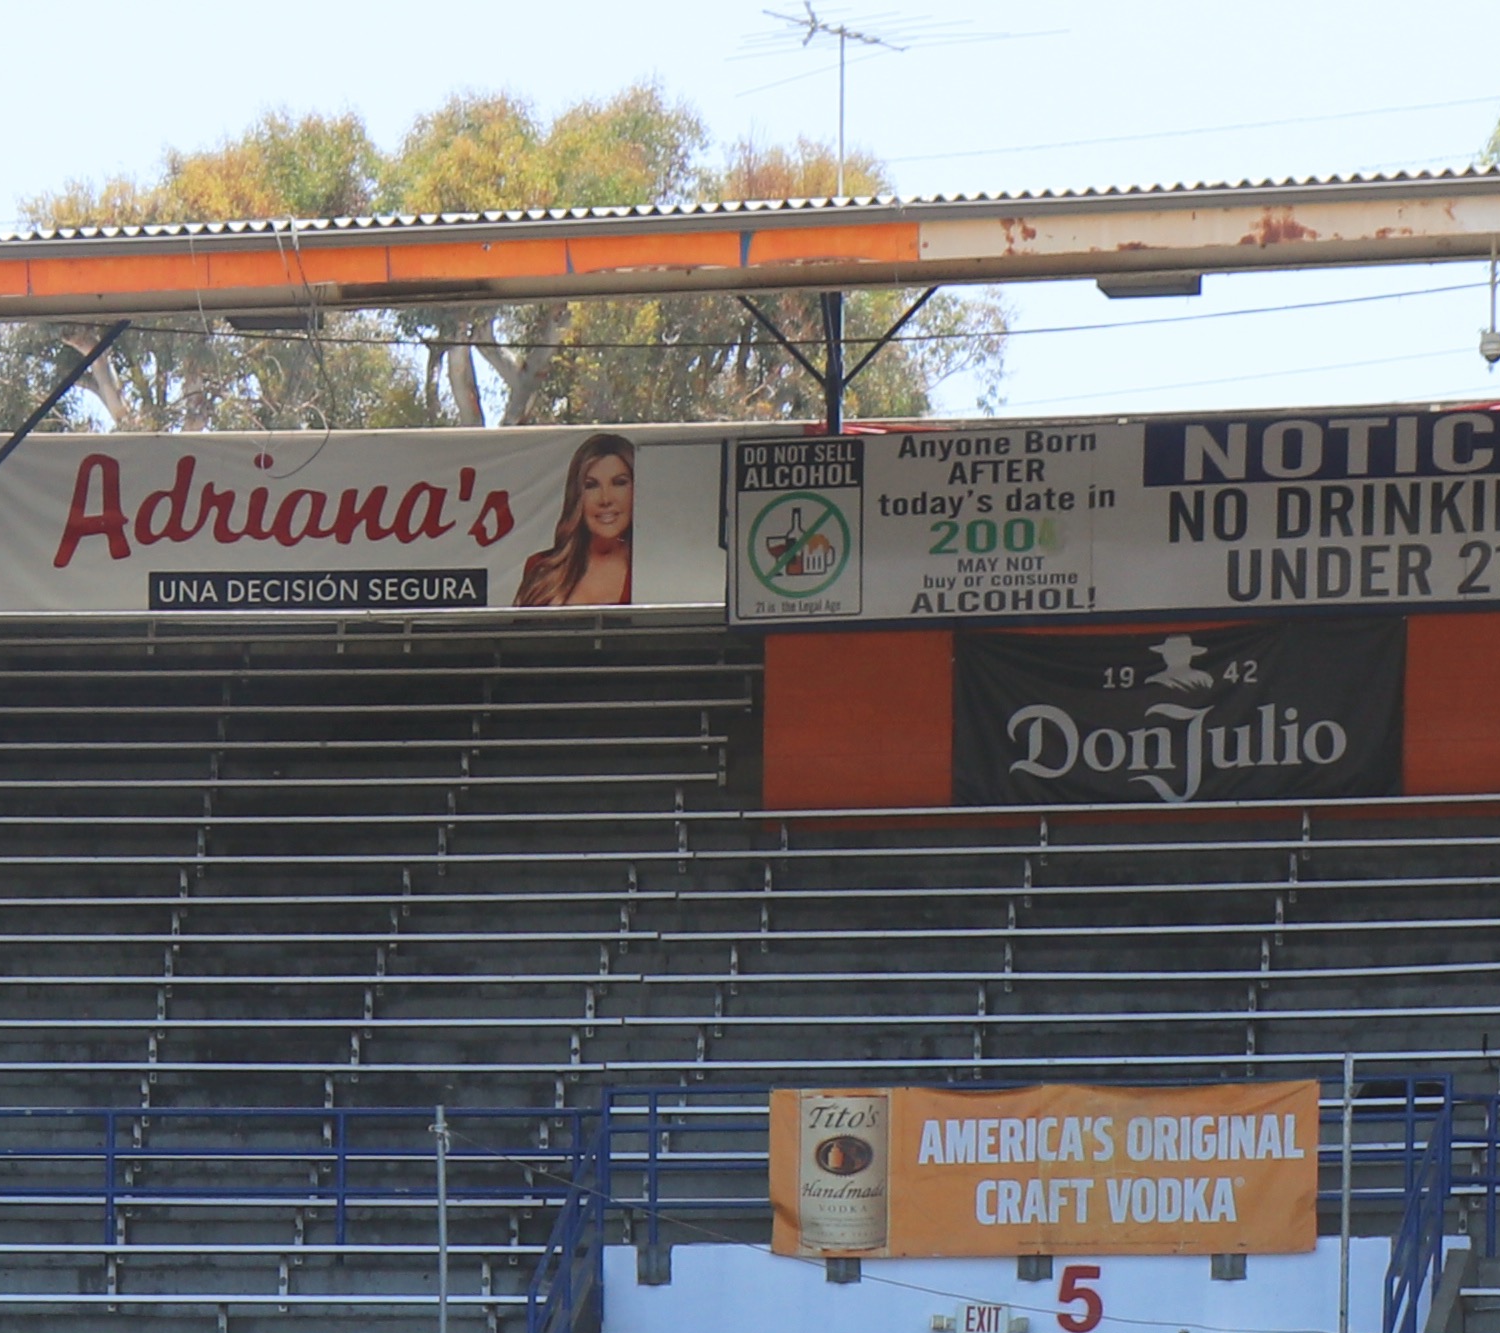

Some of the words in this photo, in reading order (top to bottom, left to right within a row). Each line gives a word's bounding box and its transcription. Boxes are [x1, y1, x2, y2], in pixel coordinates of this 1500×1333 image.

[744, 447, 768, 466] DO
[774, 445, 809, 464] NOT
[814, 443, 856, 462] SELL
[898, 434, 1011, 462] Anyone
[1025, 430, 1097, 454] Born
[744, 463, 858, 489] ALCOHOL
[948, 458, 1045, 485] AFTER
[53, 453, 516, 568] Adriana's
[878, 489, 993, 519] today's
[1005, 488, 1075, 512] date
[1088, 484, 1116, 509] in
[1168, 487, 1248, 543] NO
[957, 557, 1000, 573] MAY
[1006, 556, 1045, 572] NOT
[1227, 543, 1433, 601] UNDER
[158, 580, 220, 603] UNA
[226, 572, 362, 603] DECISIÓN
[367, 577, 477, 601] SEGURA
[923, 574, 957, 591] buy
[963, 574, 983, 587] or
[991, 572, 1078, 586] consume
[910, 586, 1096, 614] ALCOHOL!
[1103, 666, 1134, 690] 19
[1223, 660, 1258, 684] 42
[808, 1103, 880, 1129] Tito's
[918, 1115, 1115, 1166] AMERICA'S
[1126, 1113, 1305, 1162] ORIGINAL
[802, 1179, 885, 1200] Handmade
[975, 1177, 1094, 1227] CRAFT
[818, 1204, 869, 1213] VODKA
[1056, 1264, 1103, 1333] 5
[965, 1305, 1002, 1333] EXIT
